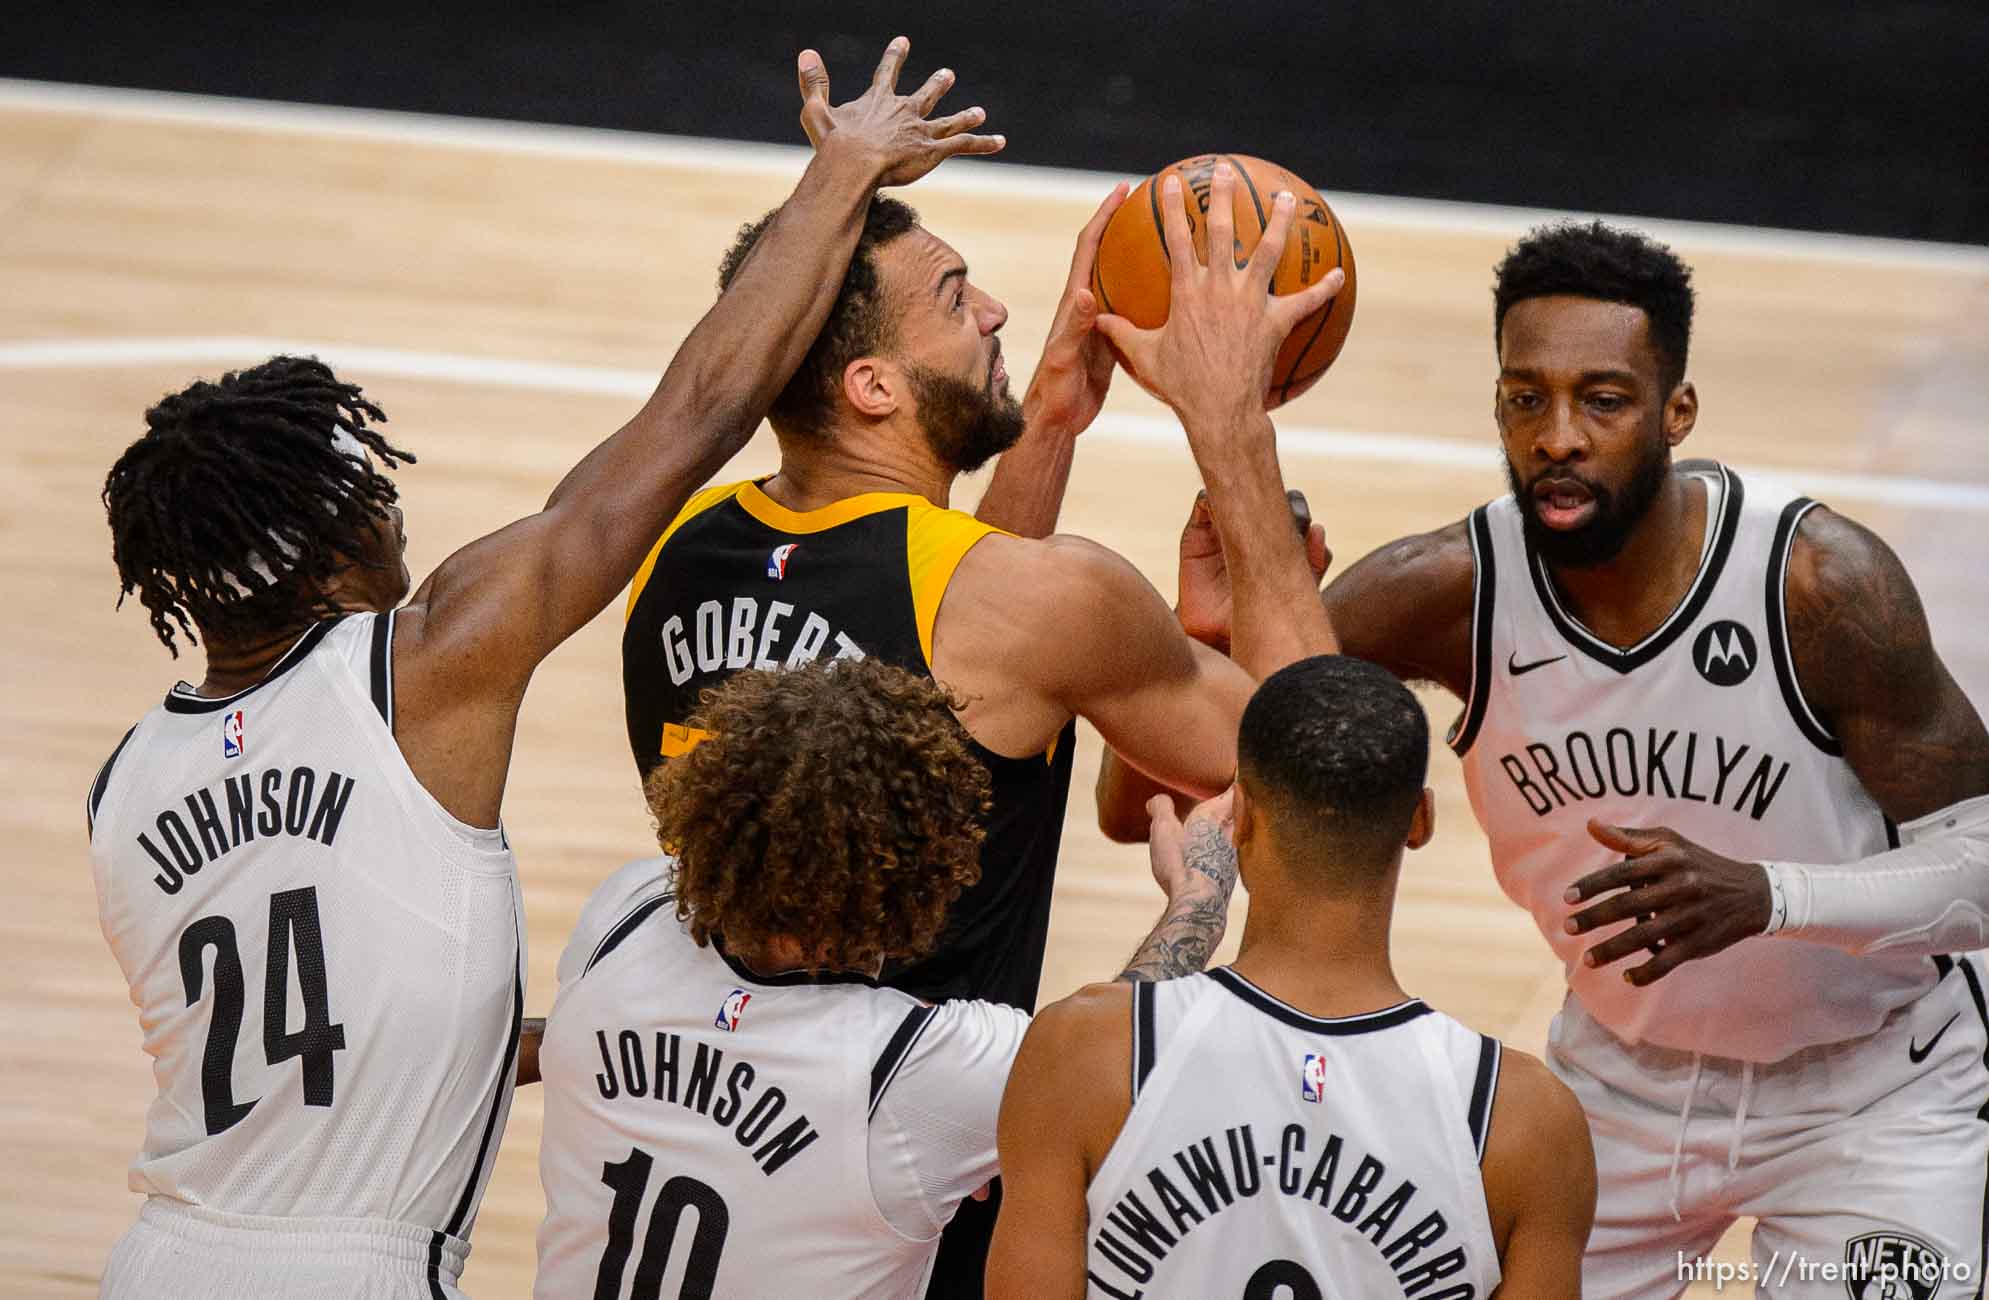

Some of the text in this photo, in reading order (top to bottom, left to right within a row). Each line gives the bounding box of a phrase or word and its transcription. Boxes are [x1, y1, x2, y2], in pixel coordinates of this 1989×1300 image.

[136, 766, 356, 896] JOHNSON
[1500, 727, 1791, 821] BROOKLYN
[178, 885, 347, 1137] 24
[595, 1029, 820, 1177] JOHNSON
